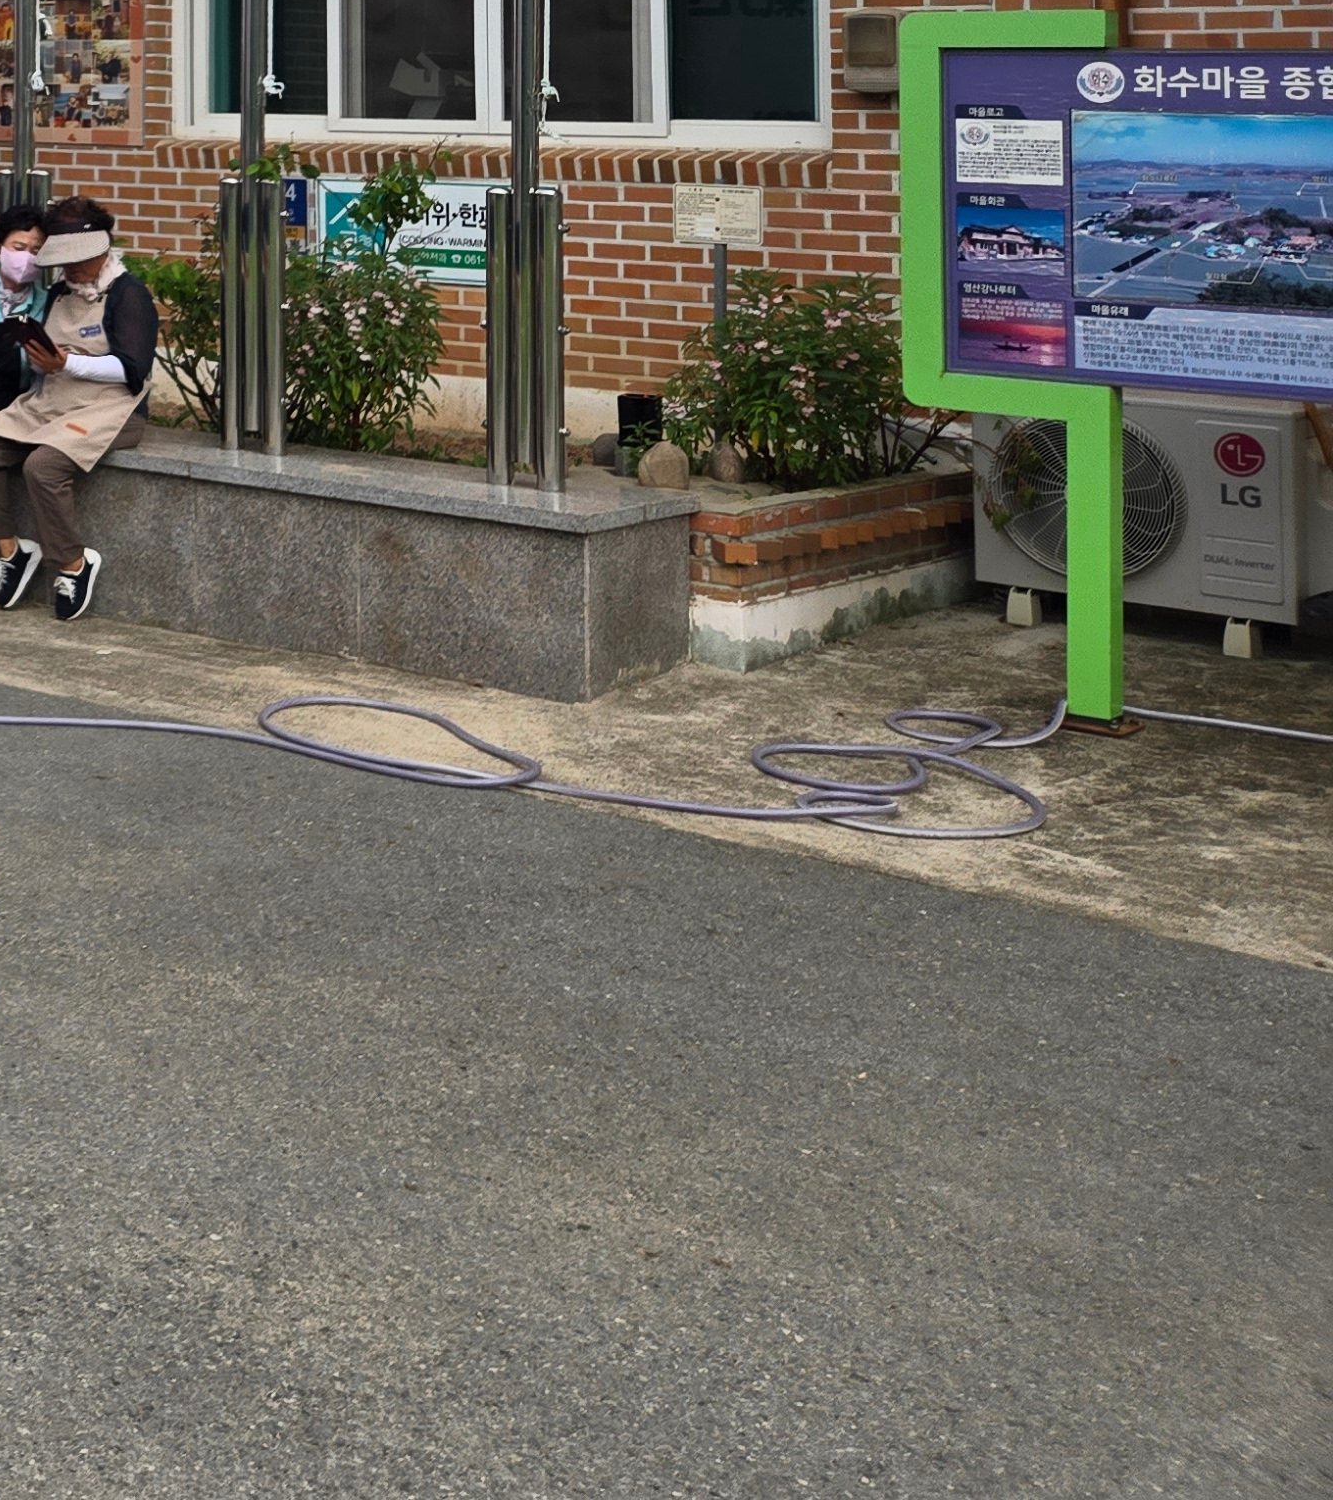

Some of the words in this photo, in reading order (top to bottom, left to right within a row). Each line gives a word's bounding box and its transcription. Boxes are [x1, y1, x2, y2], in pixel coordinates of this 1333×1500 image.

[1133, 65, 1270, 100] 화수마을
[1220, 483, 1262, 509] LG
[1204, 554, 1232, 567] DUAL
